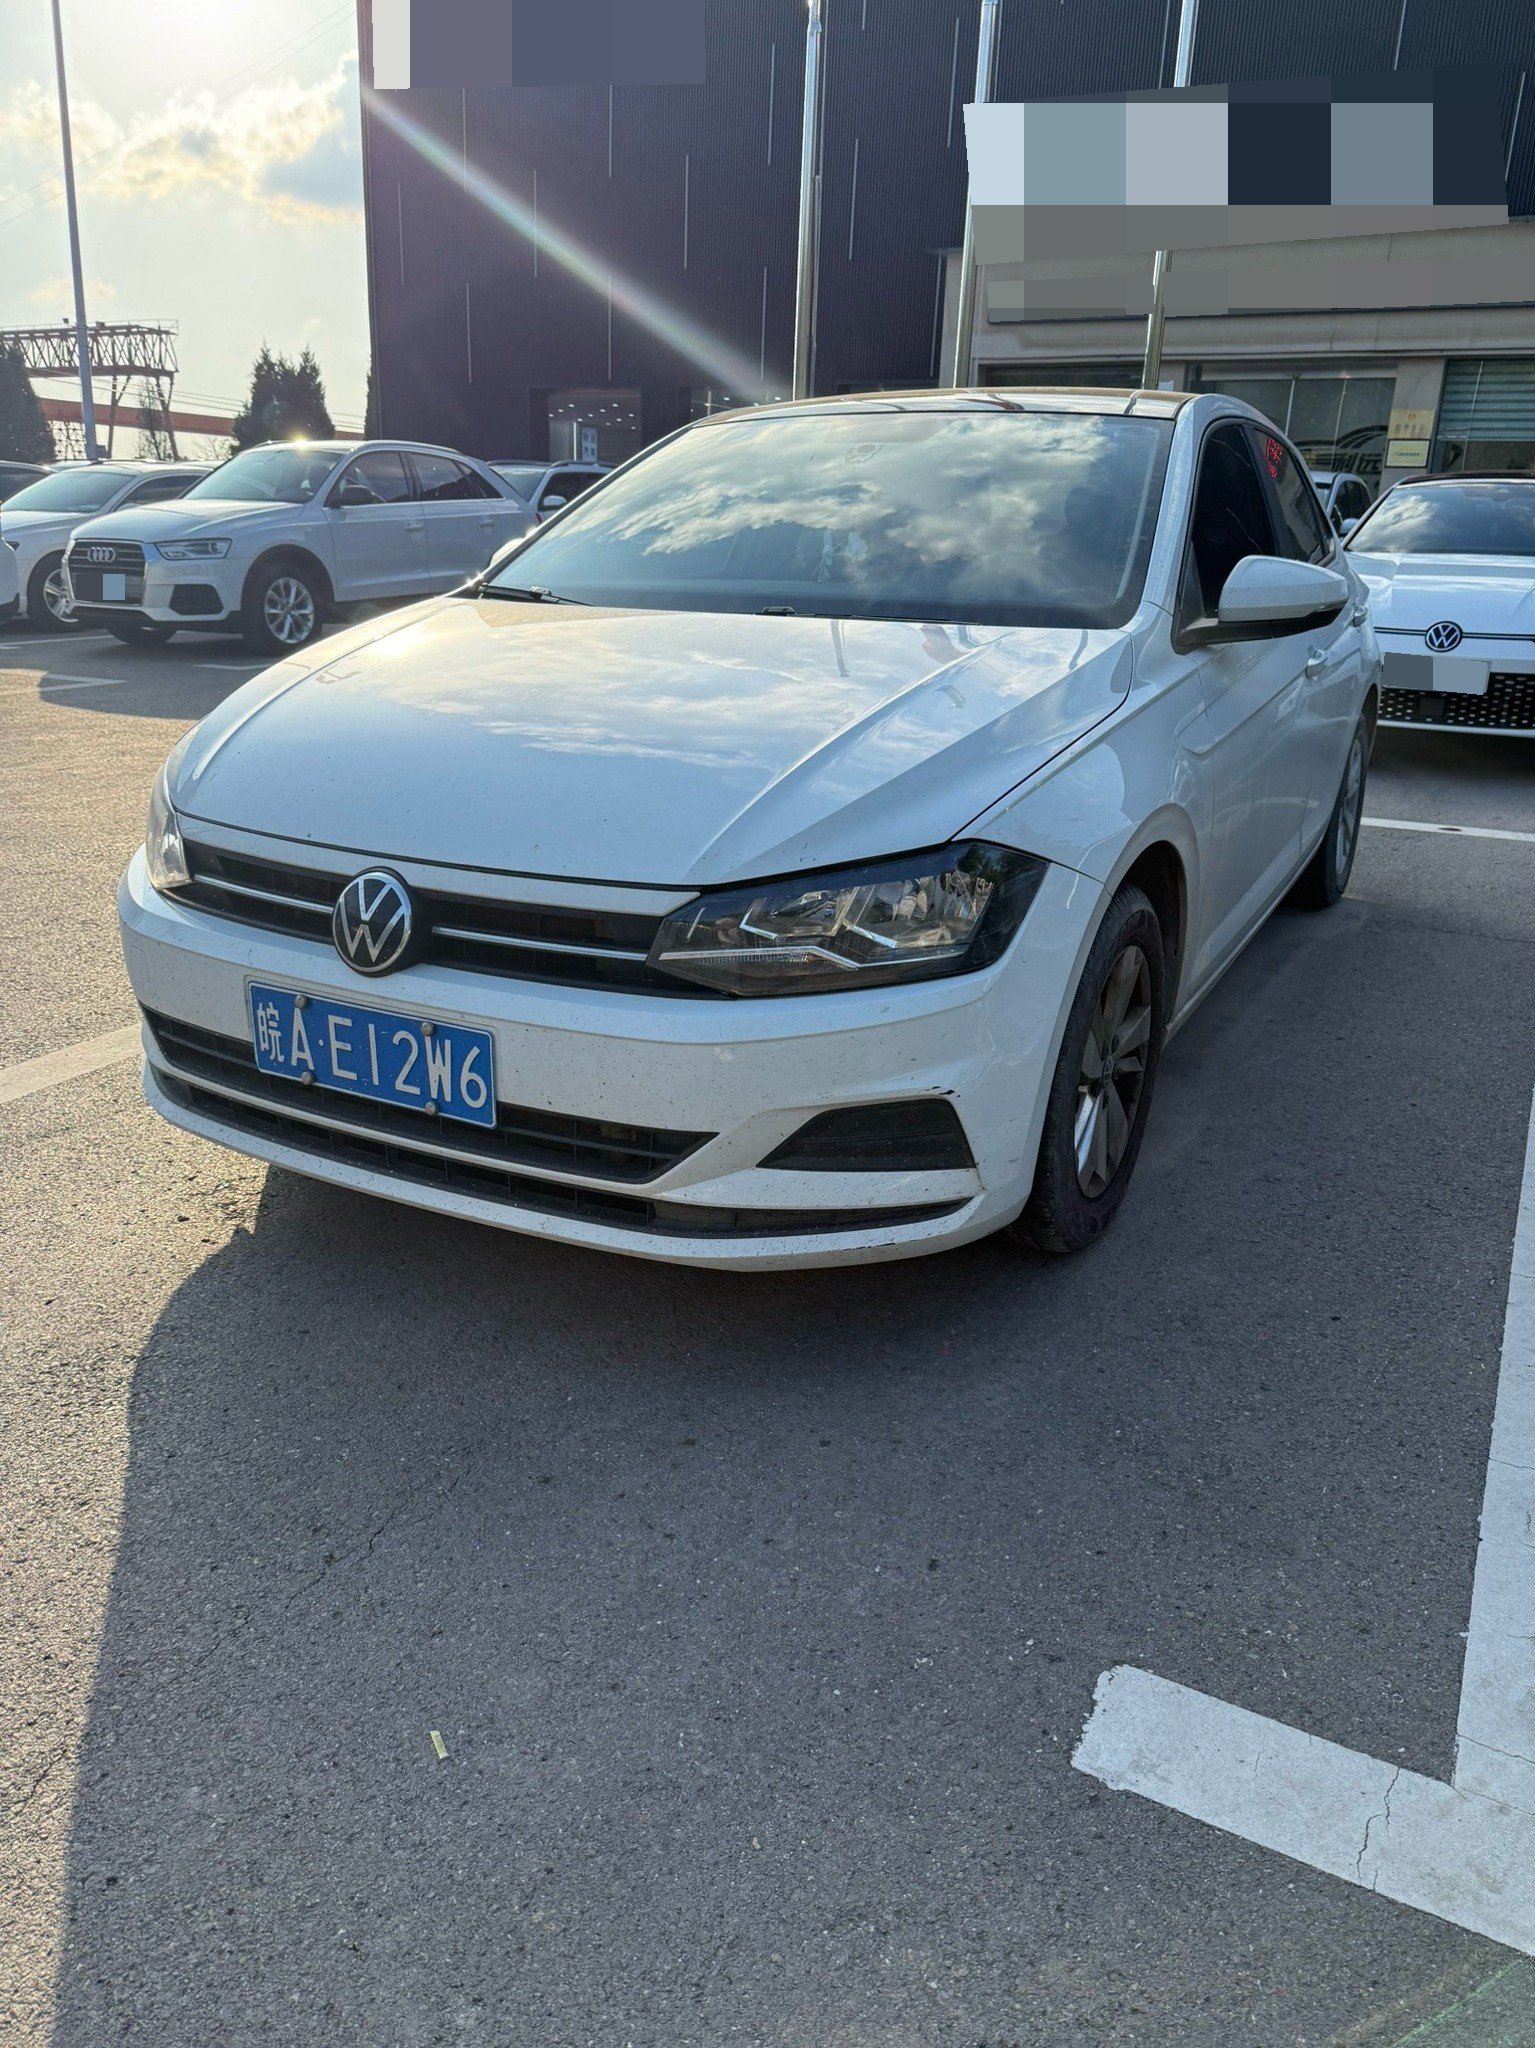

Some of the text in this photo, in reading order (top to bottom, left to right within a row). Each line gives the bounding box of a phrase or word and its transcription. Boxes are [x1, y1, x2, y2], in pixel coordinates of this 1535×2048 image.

[1427, 622, 1461, 650] VW
[335, 872, 411, 969] VW
[256, 1001, 488, 1110] 皖A·E12W6
